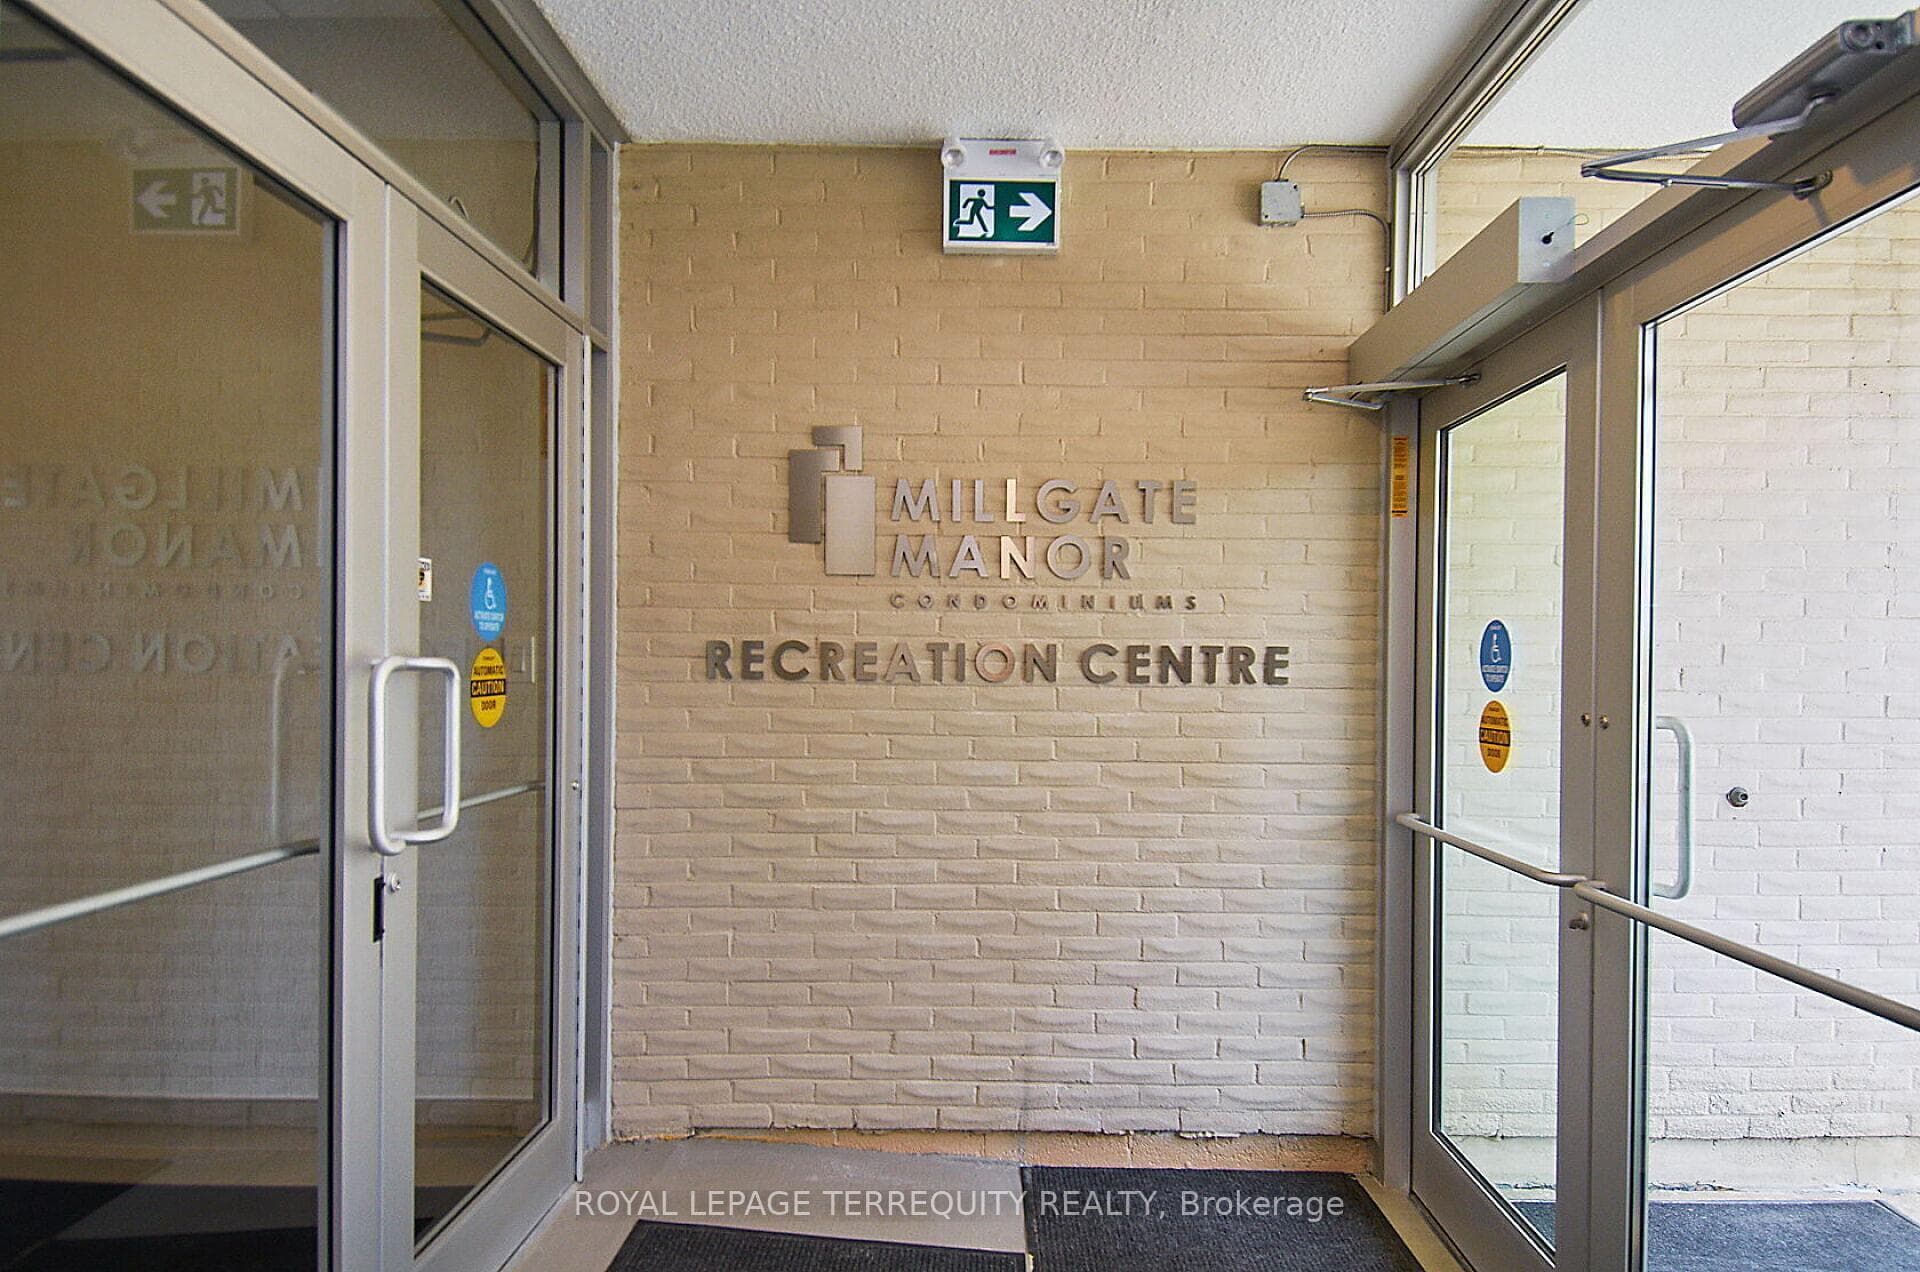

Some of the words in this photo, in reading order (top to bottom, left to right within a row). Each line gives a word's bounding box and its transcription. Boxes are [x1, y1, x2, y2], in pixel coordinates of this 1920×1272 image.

[890, 478, 1198, 524] MILLGATE
[890, 533, 1131, 580] MANOR
[890, 593, 1198, 611] CONDOMINIUMS
[705, 639, 1058, 683] RECREATION
[1081, 643, 1290, 685] CENTRE
[472, 680, 505, 695] CAUTION
